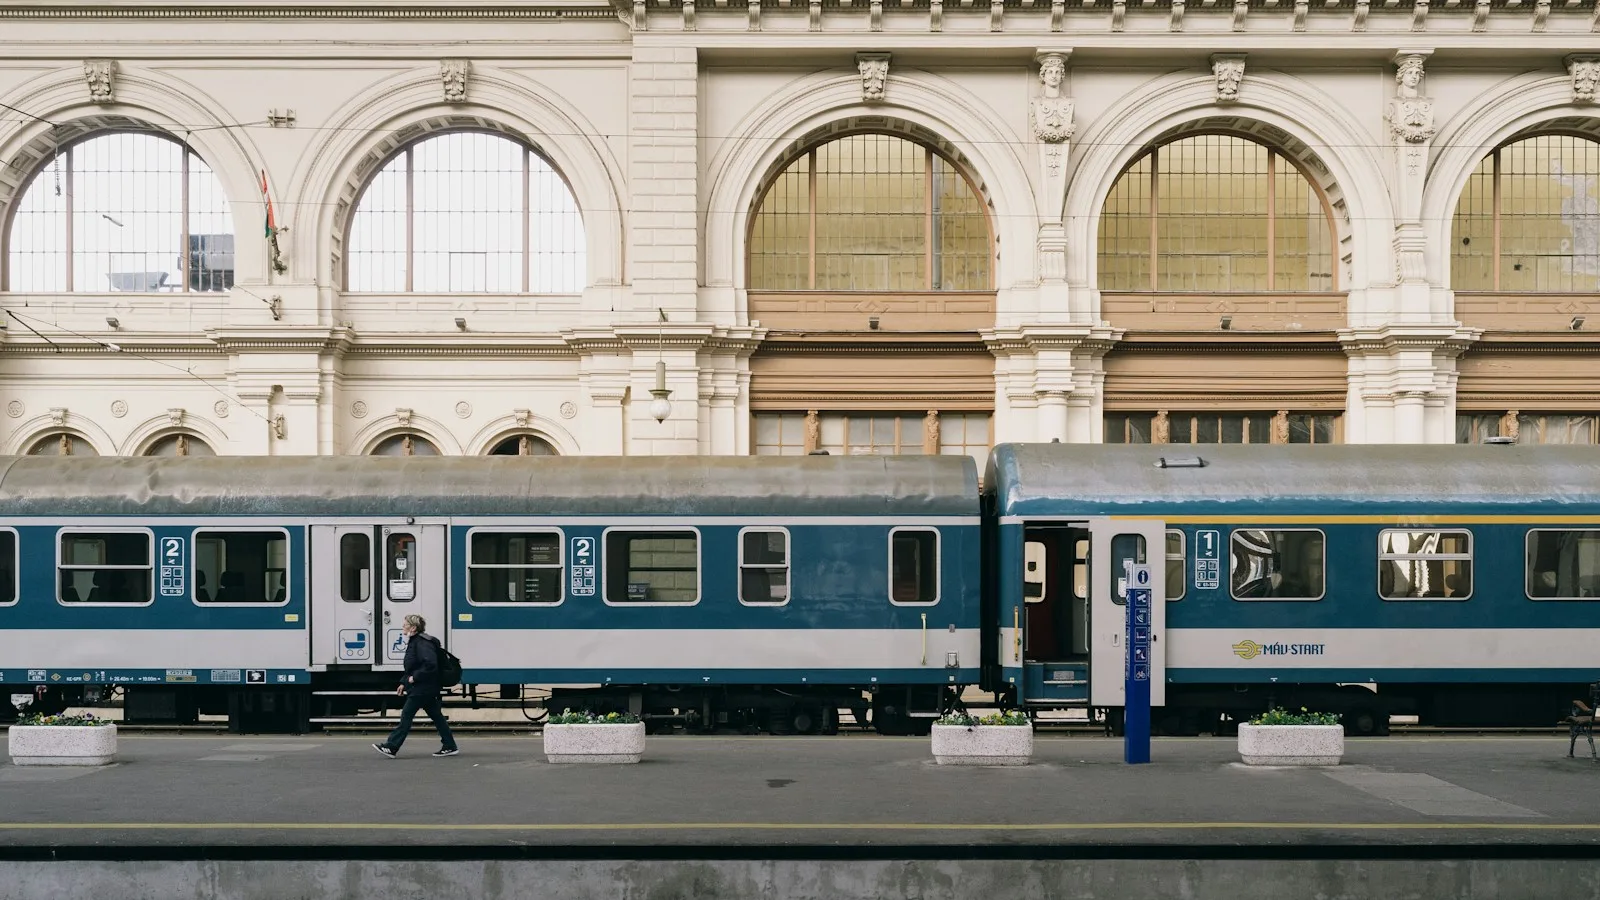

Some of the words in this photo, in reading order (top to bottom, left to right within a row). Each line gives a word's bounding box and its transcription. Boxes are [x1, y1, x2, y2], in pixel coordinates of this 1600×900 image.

[166, 539, 179, 556] 2
[576, 539, 590, 556] 2
[1203, 532, 1213, 550] 1
[1263, 641, 1325, 655] MÁV-START
